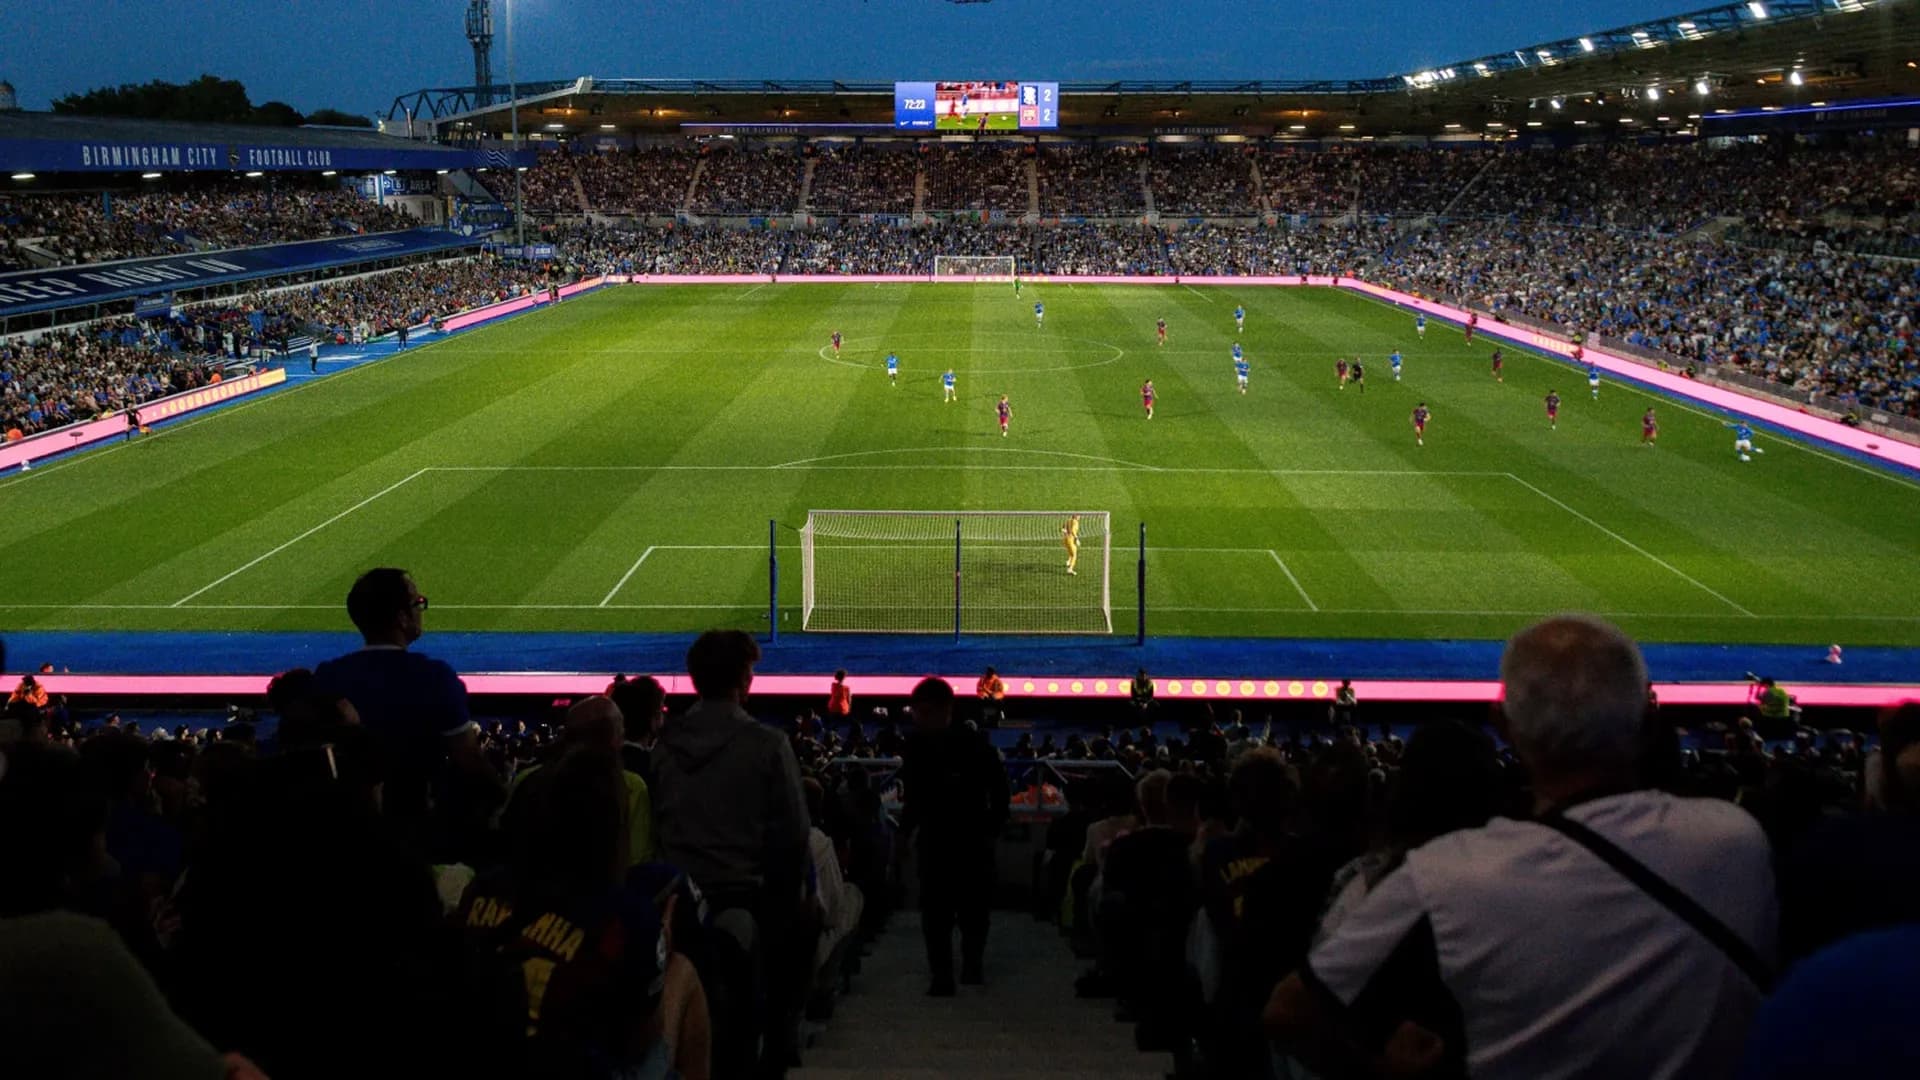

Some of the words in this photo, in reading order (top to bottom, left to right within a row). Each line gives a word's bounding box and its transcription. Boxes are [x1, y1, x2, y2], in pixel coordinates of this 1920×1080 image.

[1043, 88, 1052, 102] 2
[1043, 108, 1051, 121] 2
[82, 145, 181, 166] BIRMINGHAM
[187, 147, 217, 166] CITY
[249, 149, 302, 166] FOOTBALL
[307, 150, 332, 166] CLUB
[78, 263, 200, 288] RIGHT
[185, 258, 248, 273] ON
